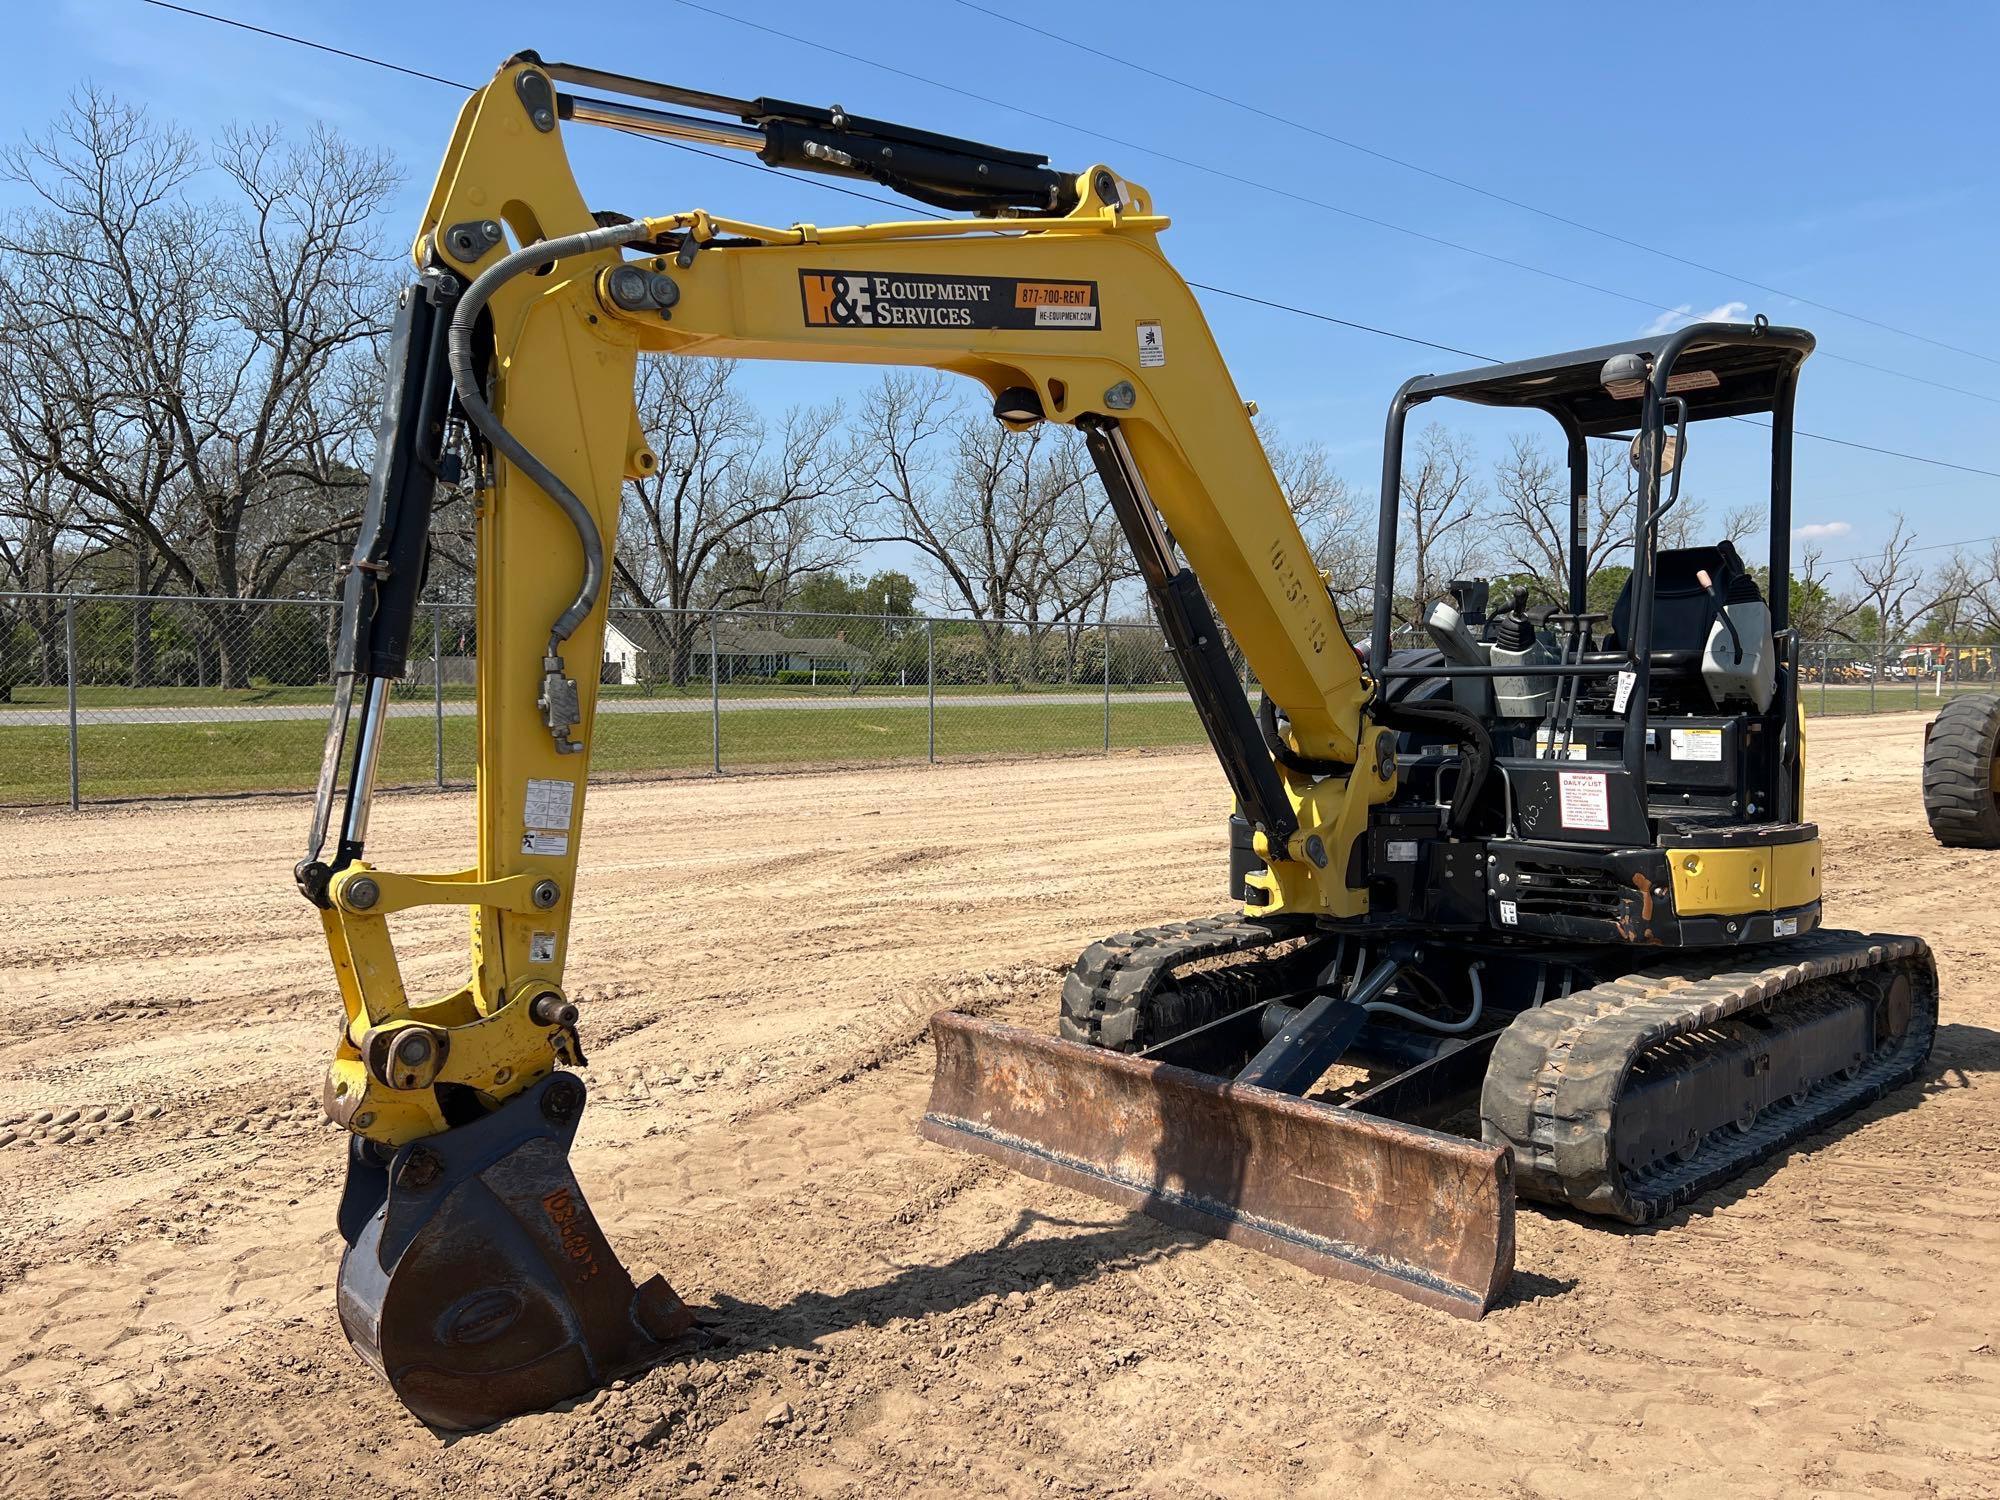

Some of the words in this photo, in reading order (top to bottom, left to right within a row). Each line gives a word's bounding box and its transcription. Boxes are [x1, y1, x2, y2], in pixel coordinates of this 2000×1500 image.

[804, 276, 872, 324] H&E
[873, 277, 990, 302] EQUIPMENT
[1022, 288, 1086, 304] 877-700-RENT
[876, 302, 970, 325] SERVICES
[1039, 311, 1092, 321] HE-EQUIPMENT.COM
